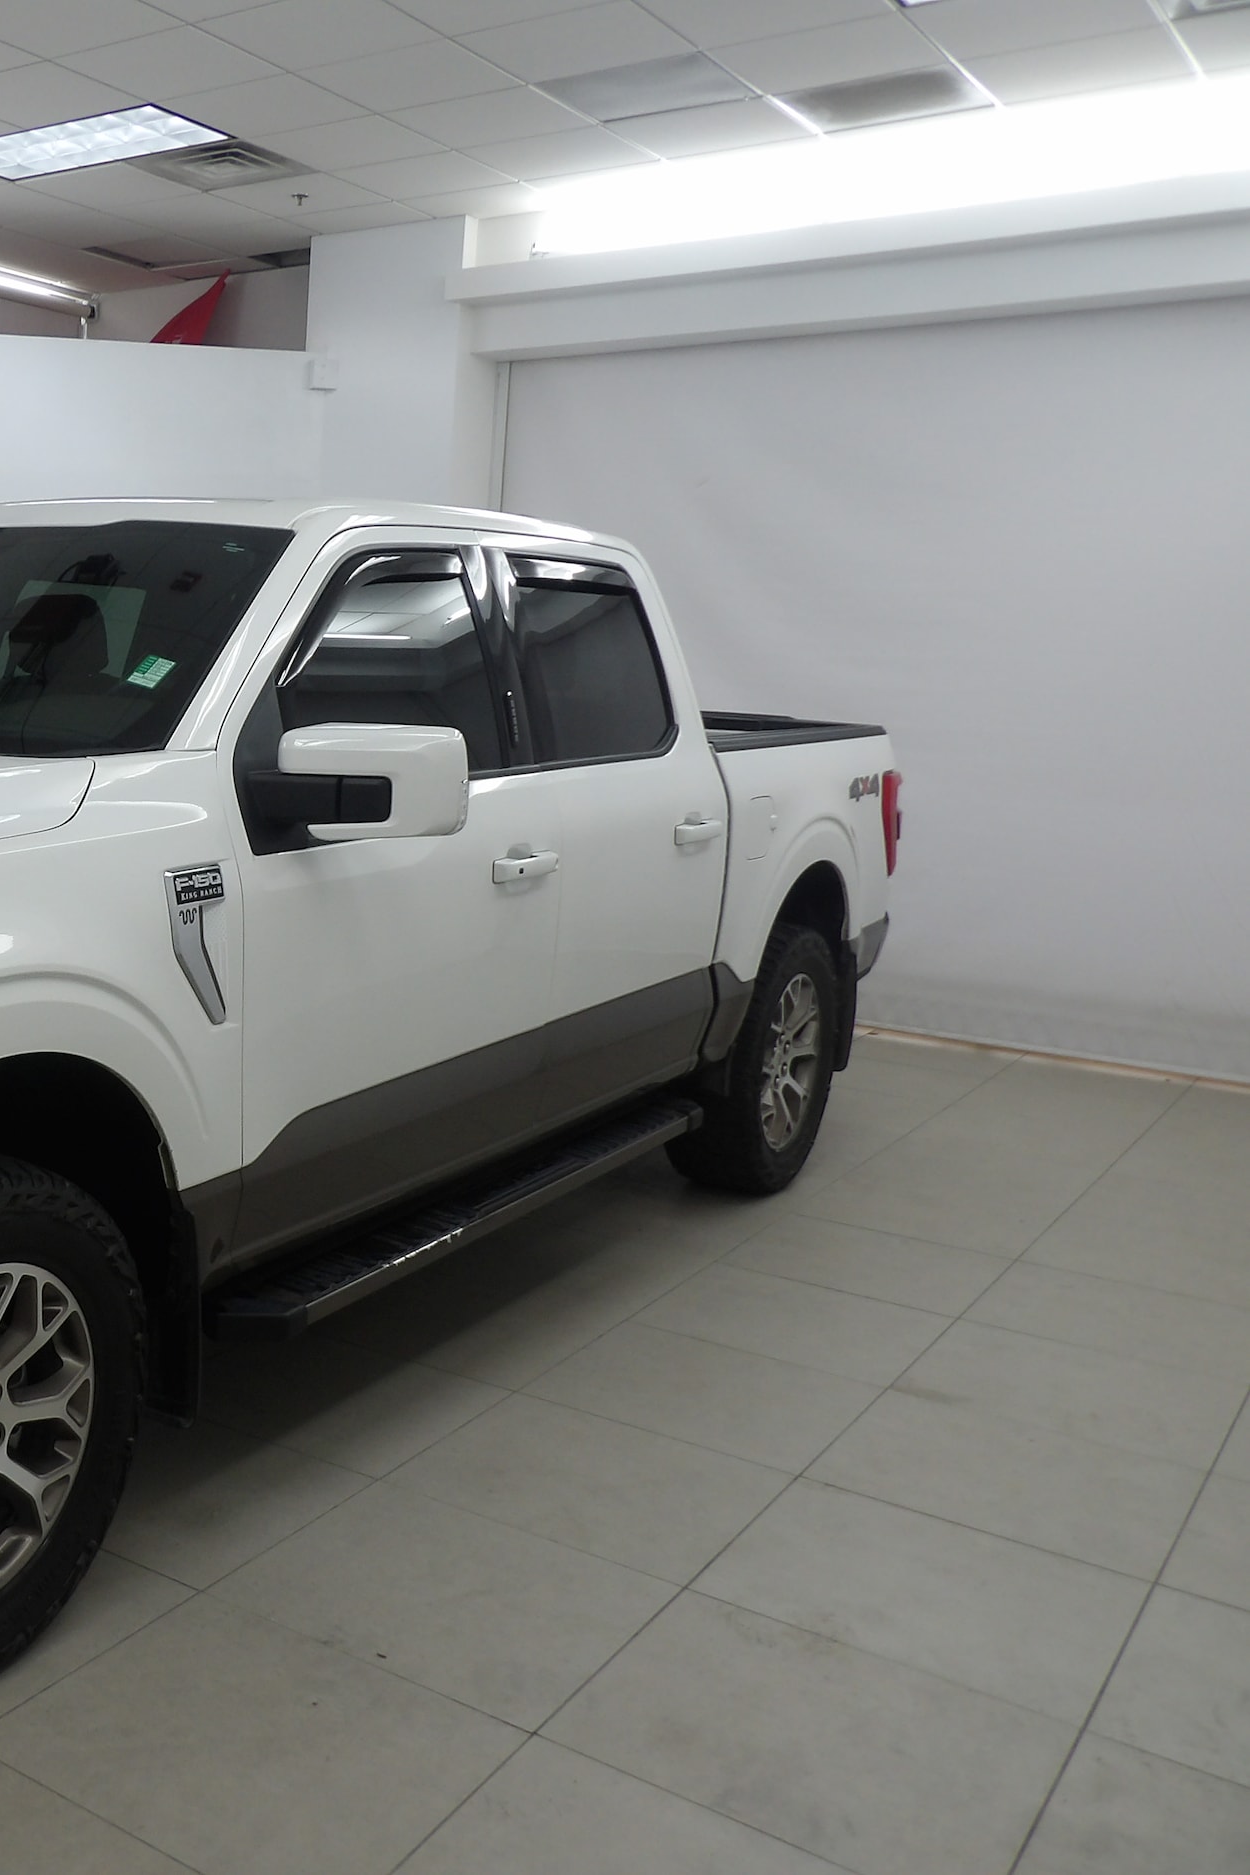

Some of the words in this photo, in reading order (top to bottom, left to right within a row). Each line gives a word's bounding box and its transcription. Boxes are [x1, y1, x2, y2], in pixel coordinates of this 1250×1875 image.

[175, 872, 222, 892] F-150
[180, 891, 198, 901] KING
[200, 886, 223, 897] RANCH
